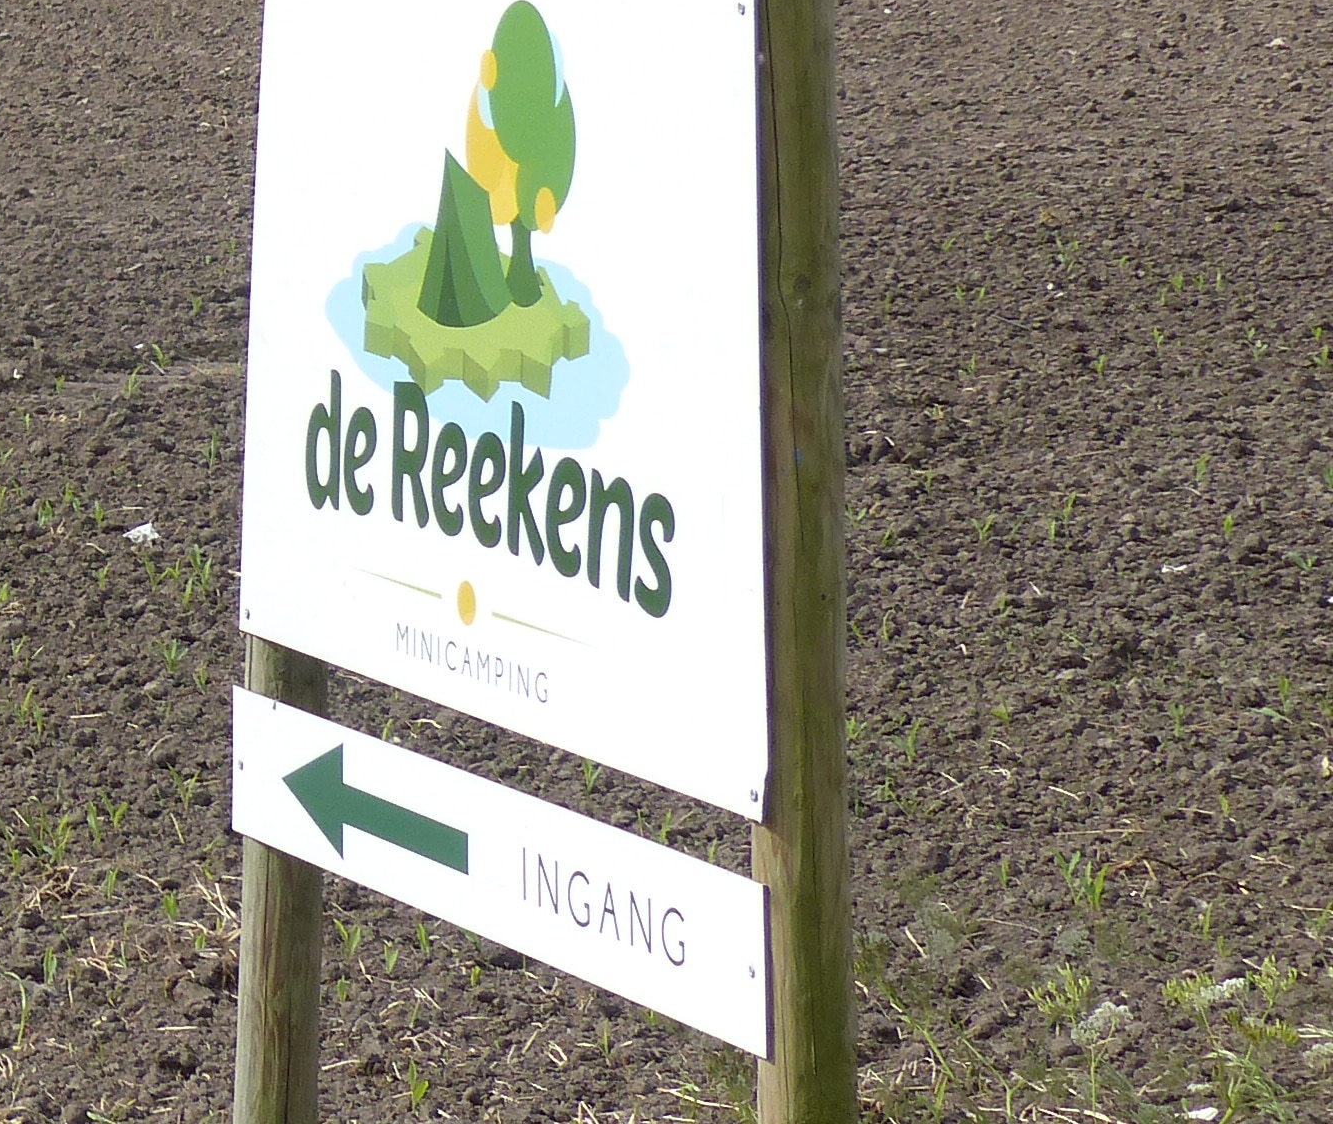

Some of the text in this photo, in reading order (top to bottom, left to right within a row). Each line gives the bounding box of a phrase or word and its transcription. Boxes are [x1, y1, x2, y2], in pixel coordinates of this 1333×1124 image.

[305, 369, 675, 618] de Reekens
[396, 622, 548, 703] MINICAMPING
[523, 847, 685, 966] INGANG
